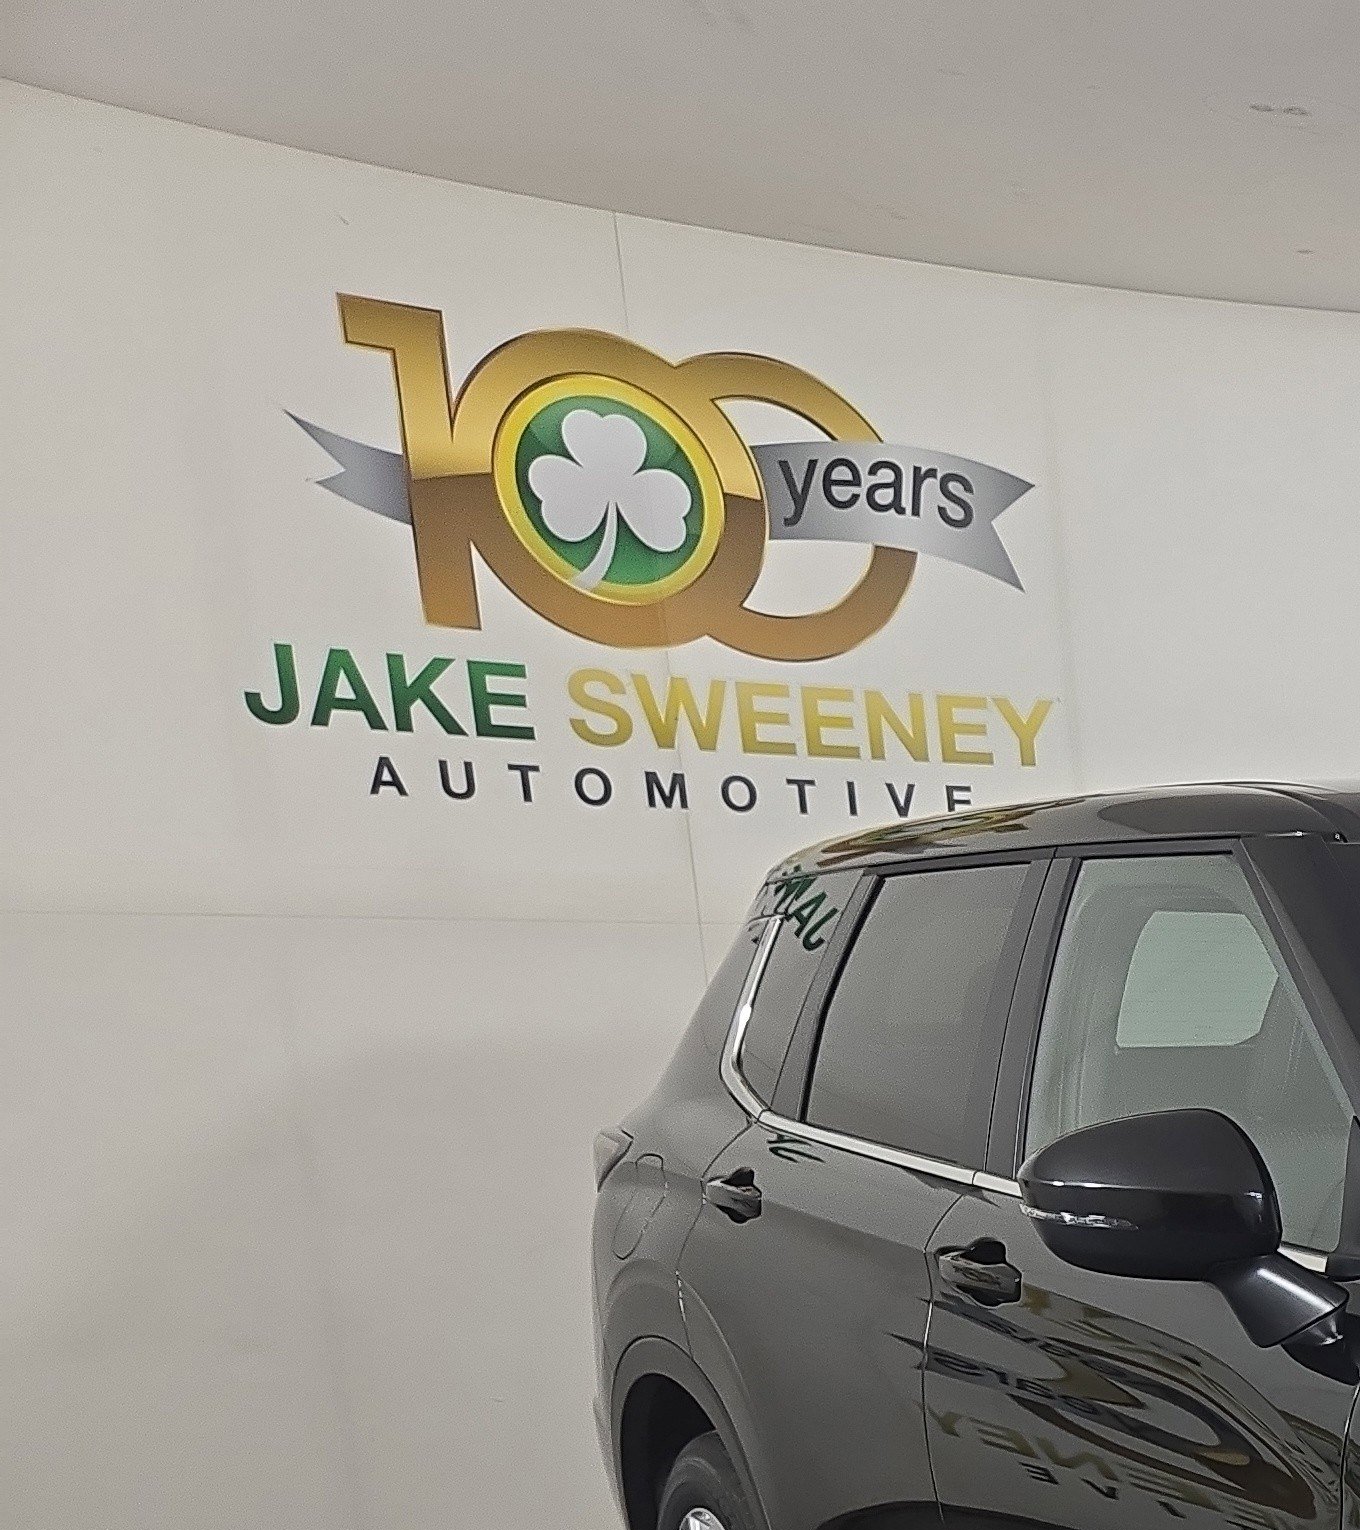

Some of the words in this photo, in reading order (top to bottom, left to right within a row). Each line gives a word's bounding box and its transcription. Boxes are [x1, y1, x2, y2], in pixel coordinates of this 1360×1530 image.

[336, 292, 917, 661] 100
[777, 450, 977, 528] years
[244, 642, 538, 740] JAKE
[568, 667, 1052, 767] SWEENEY
[369, 755, 974, 818] AUTOMOTIVE
